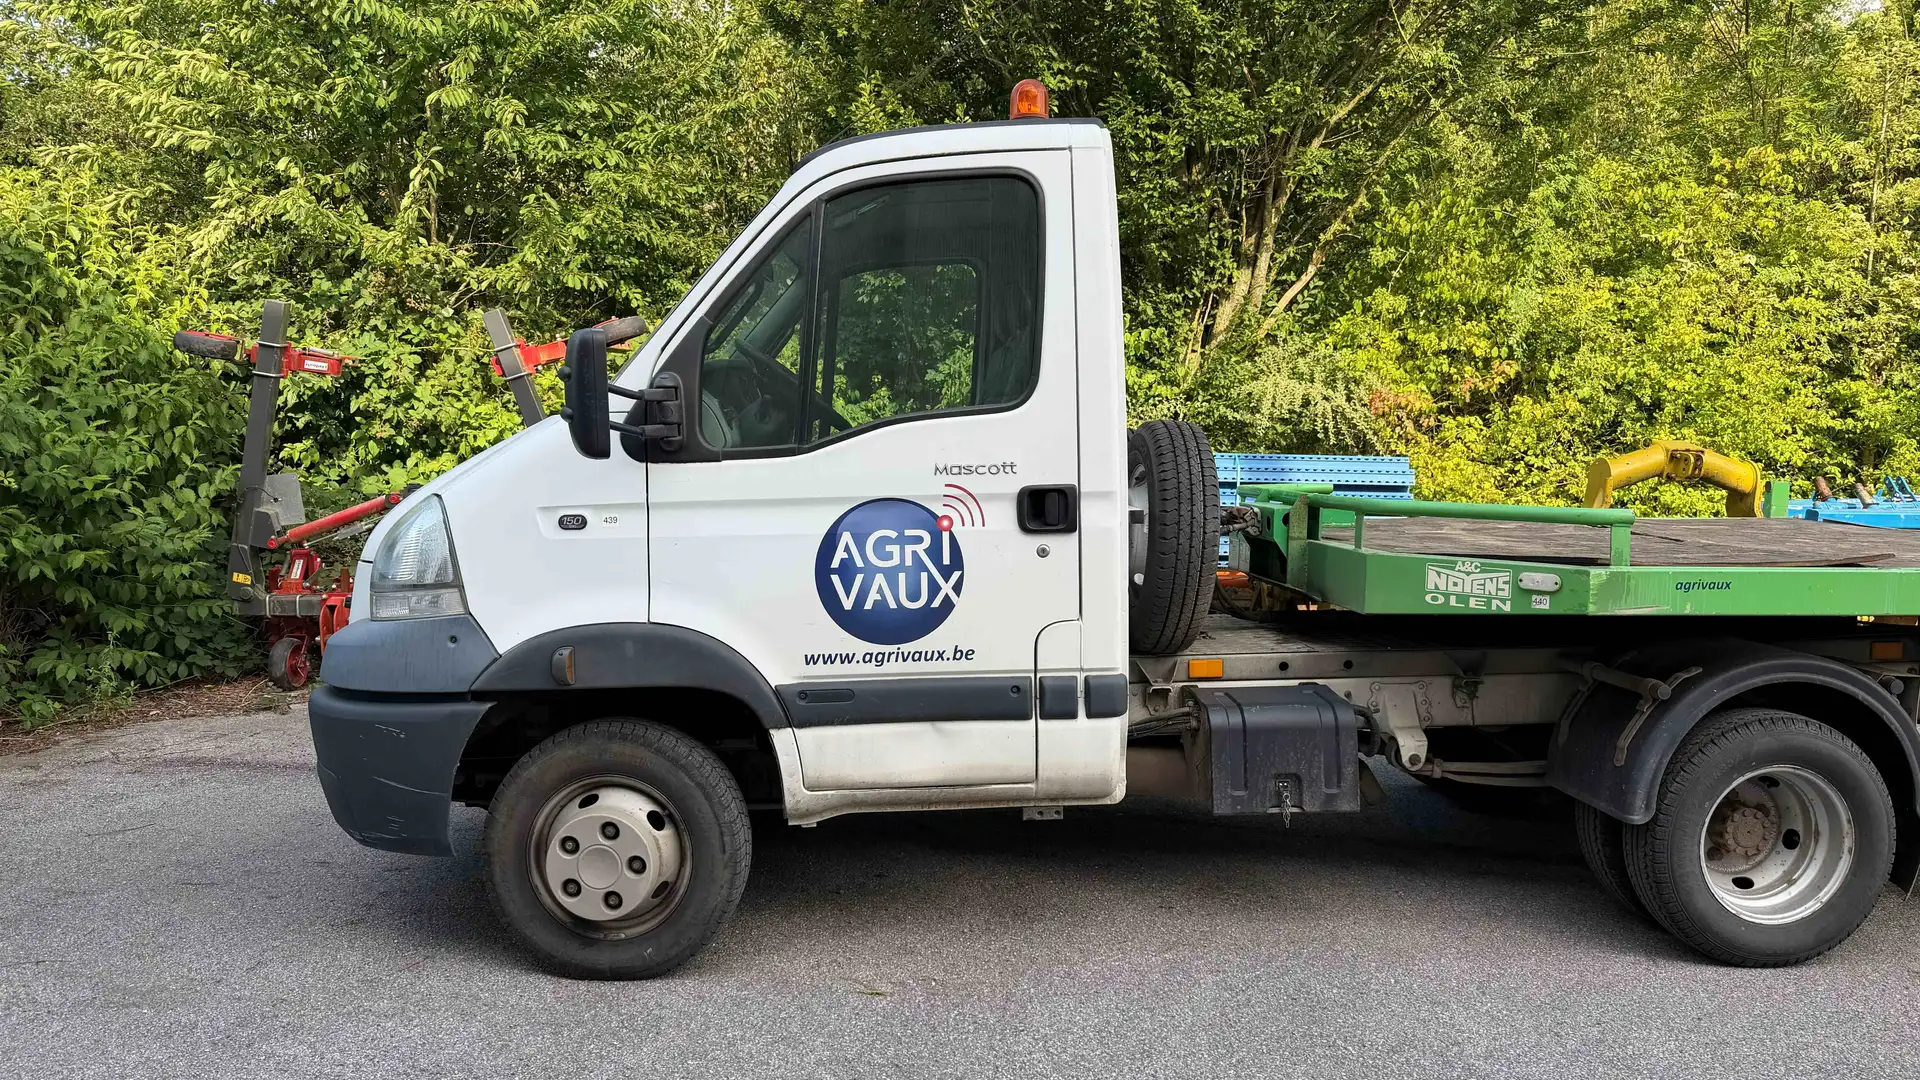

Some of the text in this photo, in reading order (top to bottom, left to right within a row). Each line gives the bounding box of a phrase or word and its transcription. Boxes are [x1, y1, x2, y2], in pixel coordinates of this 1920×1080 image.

[934, 462, 1017, 476] Mascott
[562, 516, 582, 525] 150
[603, 516, 618, 524] 439
[1455, 561, 1481, 573] A&C
[1427, 566, 1510, 597] NOYENS
[1675, 579, 1732, 593] agrivaux
[830, 571, 962, 610] VAUX
[1425, 593, 1511, 612] OLEN
[804, 645, 975, 667] www.agrivaux.be
